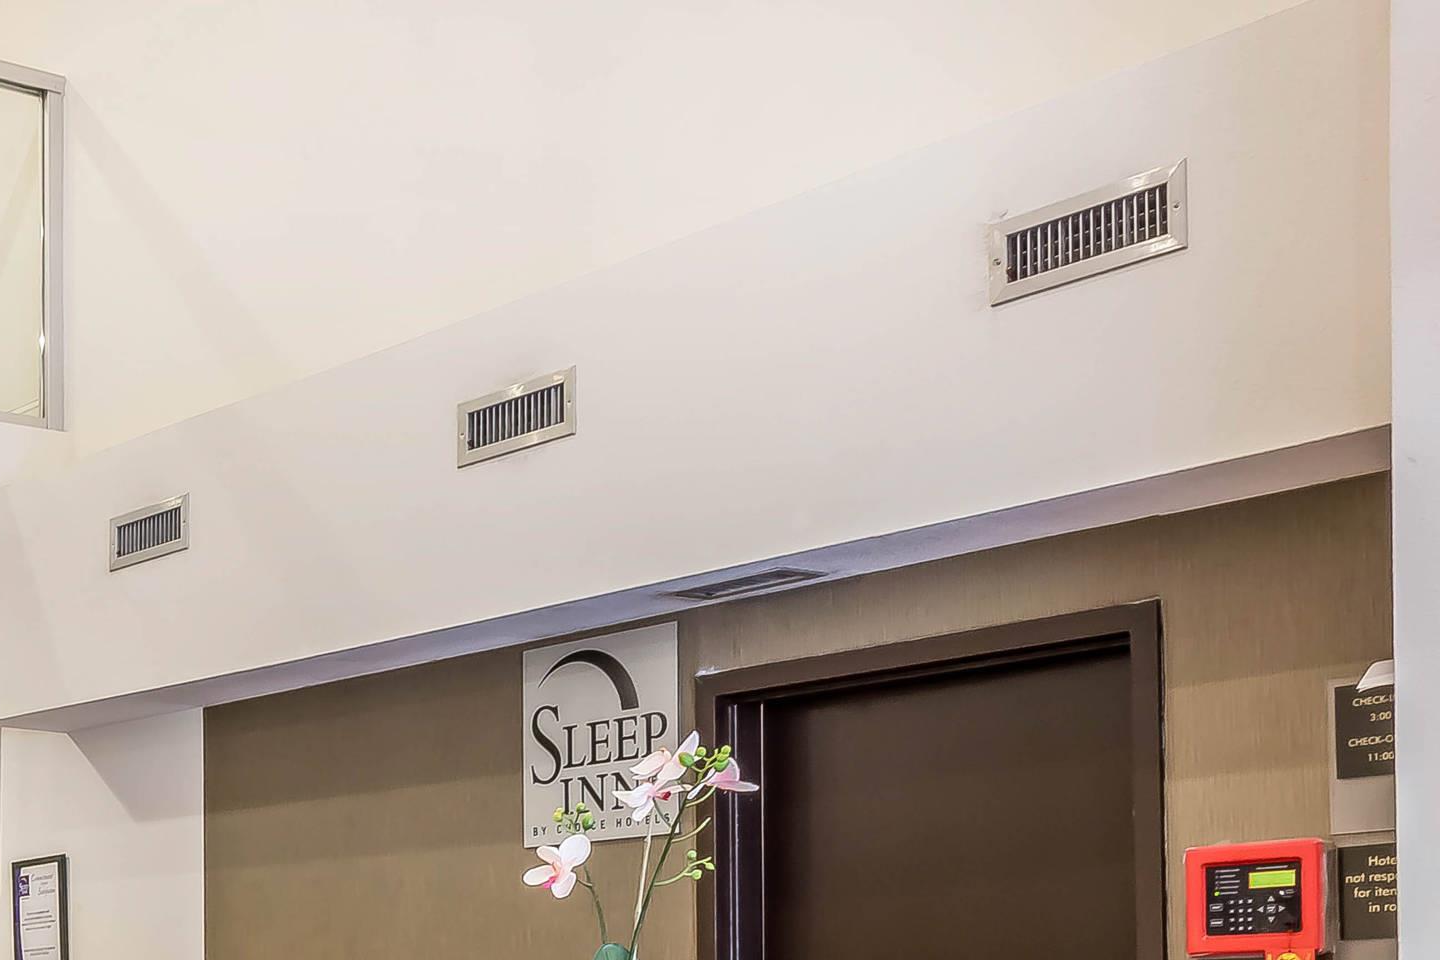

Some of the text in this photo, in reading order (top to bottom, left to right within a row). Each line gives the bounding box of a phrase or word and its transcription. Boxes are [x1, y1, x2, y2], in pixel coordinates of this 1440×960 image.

[1351, 695, 1393, 707] CHECK-I
[1369, 711, 1392, 721] 3:00
[531, 705, 668, 785] SLEEP
[1367, 751, 1395, 762] 11:00
[533, 813, 671, 837] BY COCE HOELS
[1345, 872, 1397, 884] not resp
[1353, 886, 1371, 898] for
[1368, 902, 1380, 912] in
